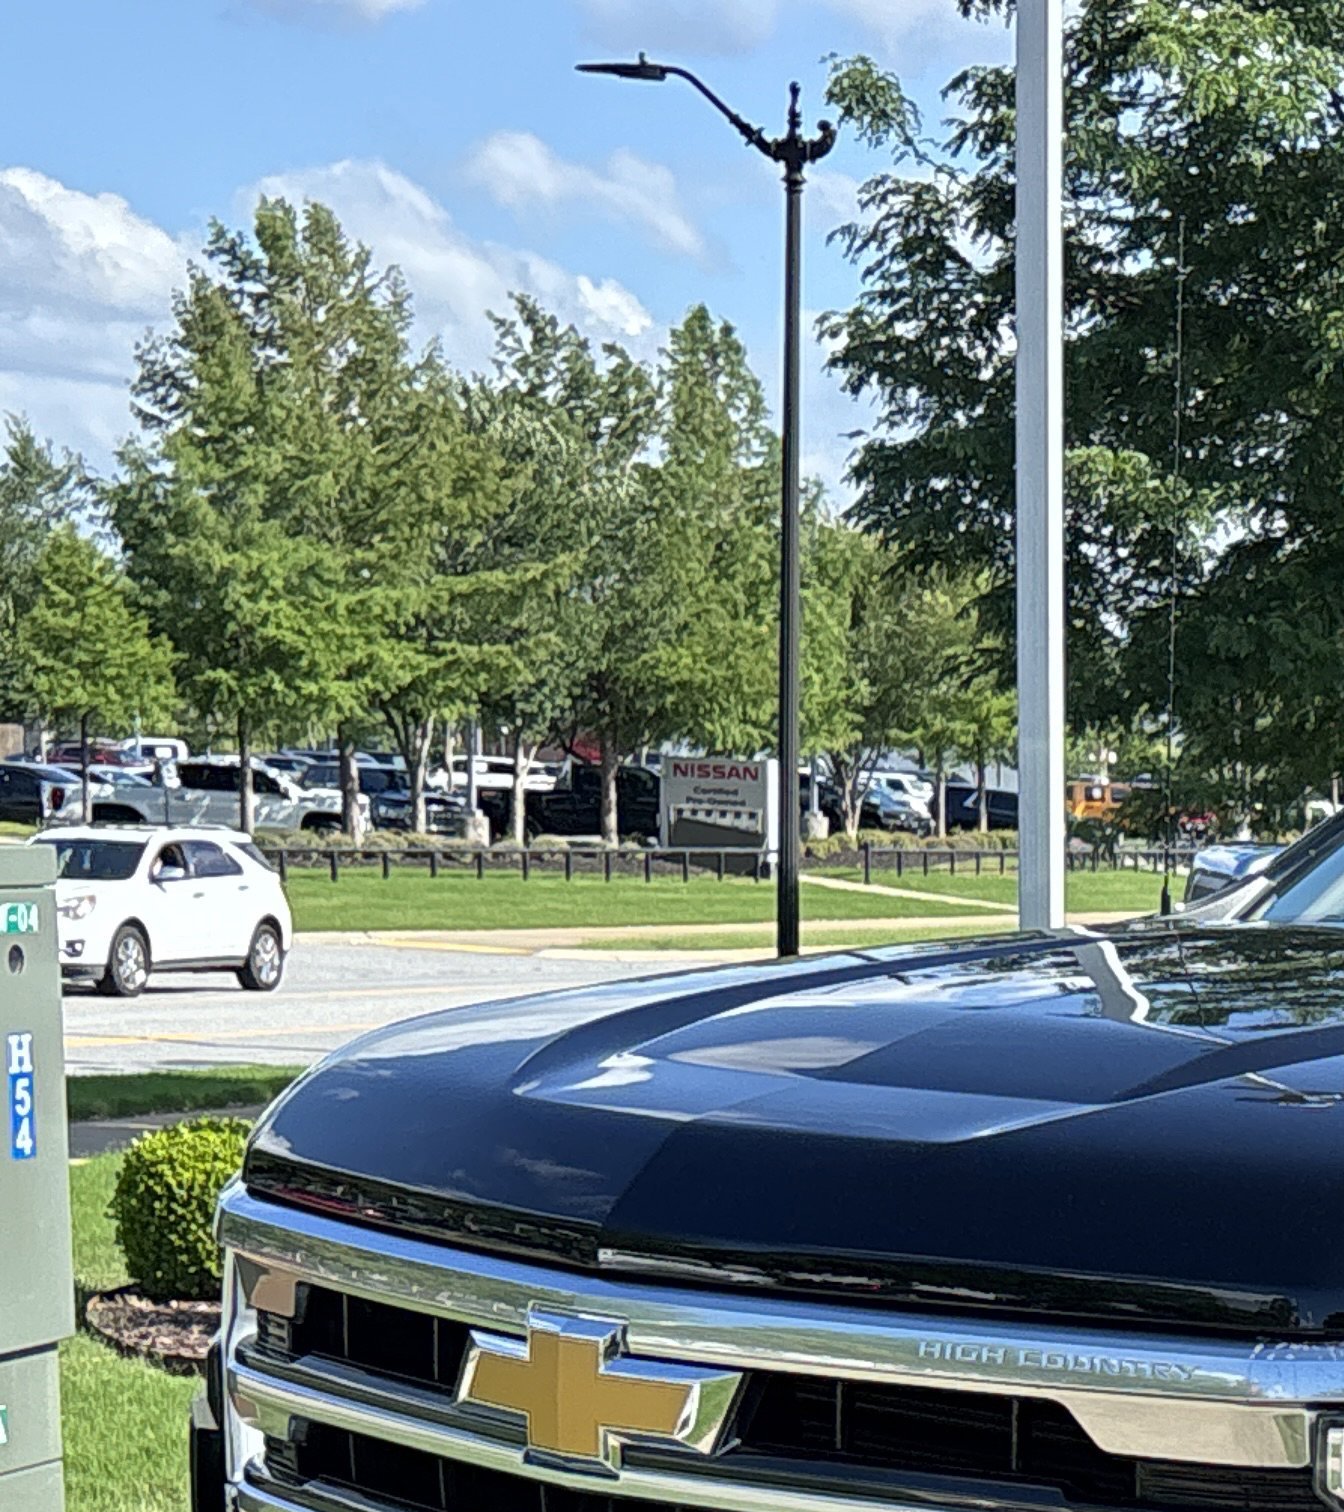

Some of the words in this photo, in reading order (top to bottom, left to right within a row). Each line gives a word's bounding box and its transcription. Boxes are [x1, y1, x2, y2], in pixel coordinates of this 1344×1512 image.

[672, 763, 759, 781] NISSAN
[918, 1340, 1005, 1366] HIGH
[1017, 1350, 1197, 1382] COUNTRY
